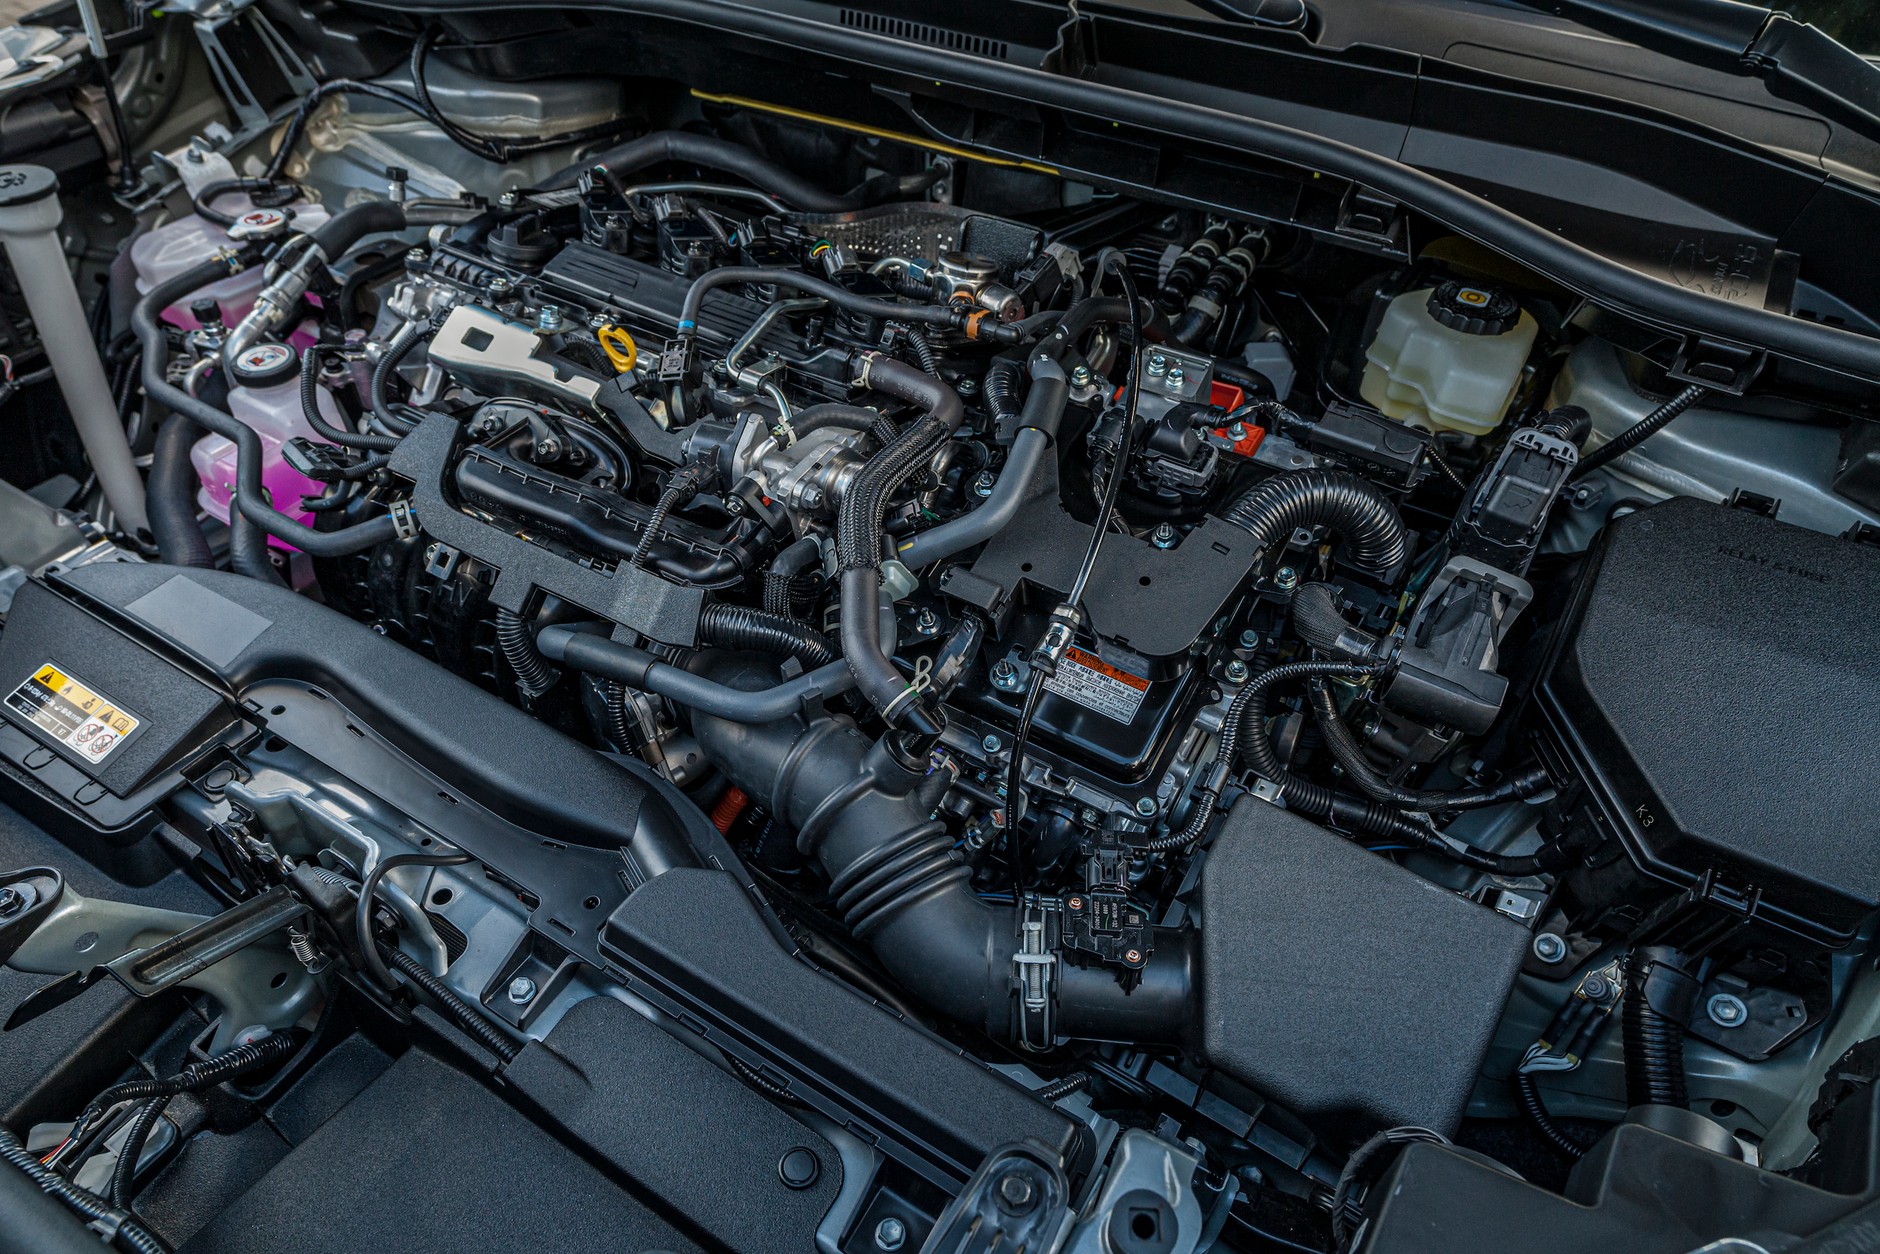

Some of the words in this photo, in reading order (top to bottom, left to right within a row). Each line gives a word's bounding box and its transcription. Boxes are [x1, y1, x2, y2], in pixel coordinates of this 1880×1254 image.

[1718, 545, 1769, 565] RELAY
[1787, 566, 1829, 582] FUSE
[1636, 804, 1654, 827] K3
